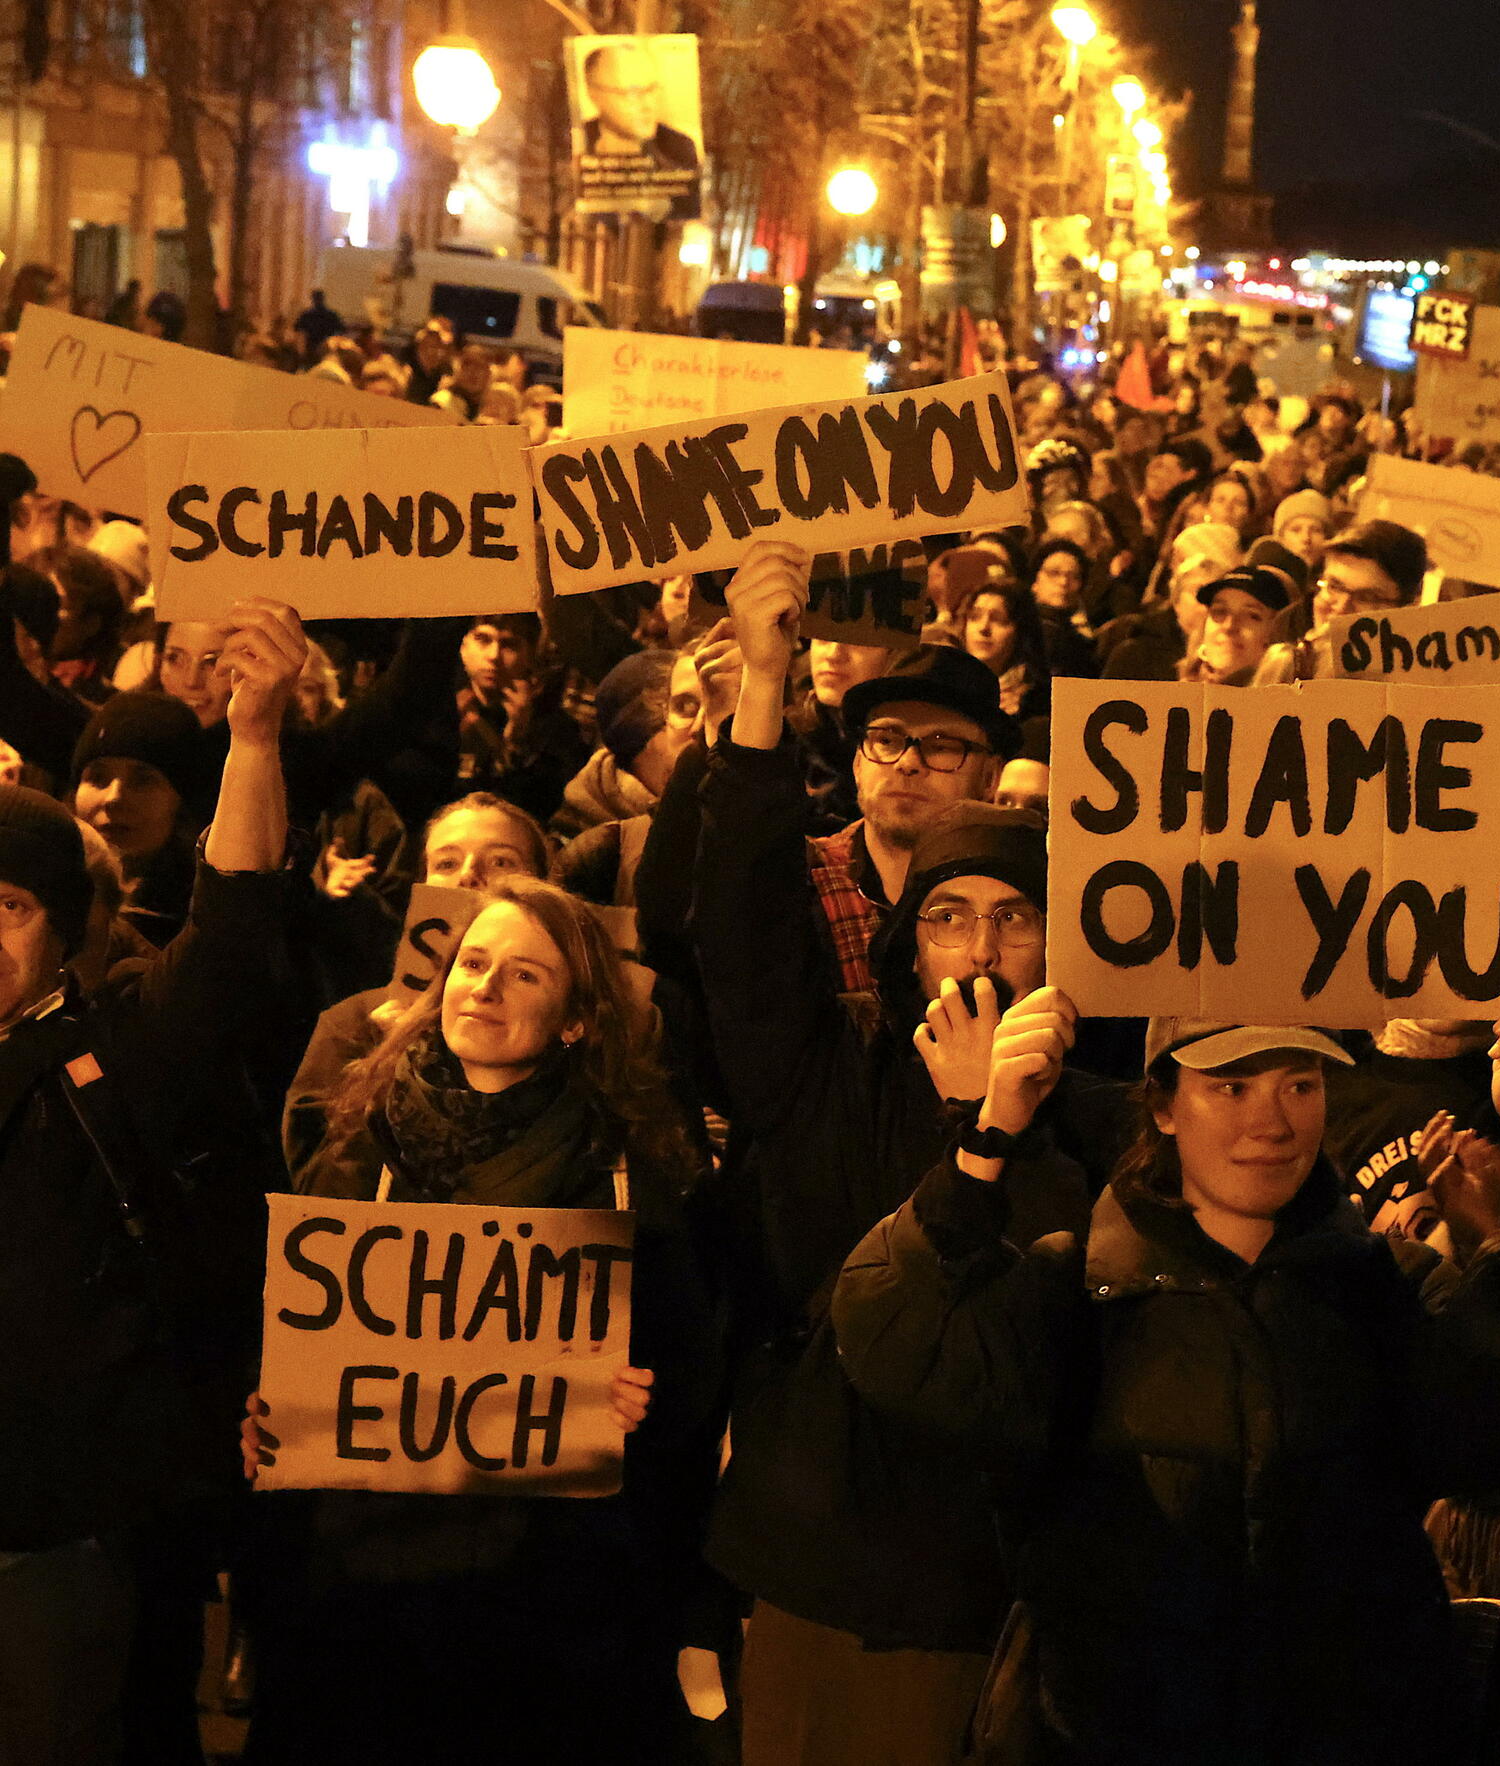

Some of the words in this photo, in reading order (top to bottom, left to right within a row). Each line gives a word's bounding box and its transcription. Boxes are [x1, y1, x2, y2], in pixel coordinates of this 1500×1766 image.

[45, 334, 155, 392] MIT
[1418, 295, 1468, 327] FCK
[167, 485, 519, 561] SCHANDE
[542, 424, 781, 569] SHAME
[776, 405, 881, 520] ON
[864, 393, 1018, 520] YOU
[1070, 700, 1483, 838] SHAME
[1080, 860, 1239, 971] ON
[1355, 1137, 1408, 1190] DREI
[278, 1217, 633, 1342] SCHÄMT
[337, 1365, 567, 1471] EUCH
